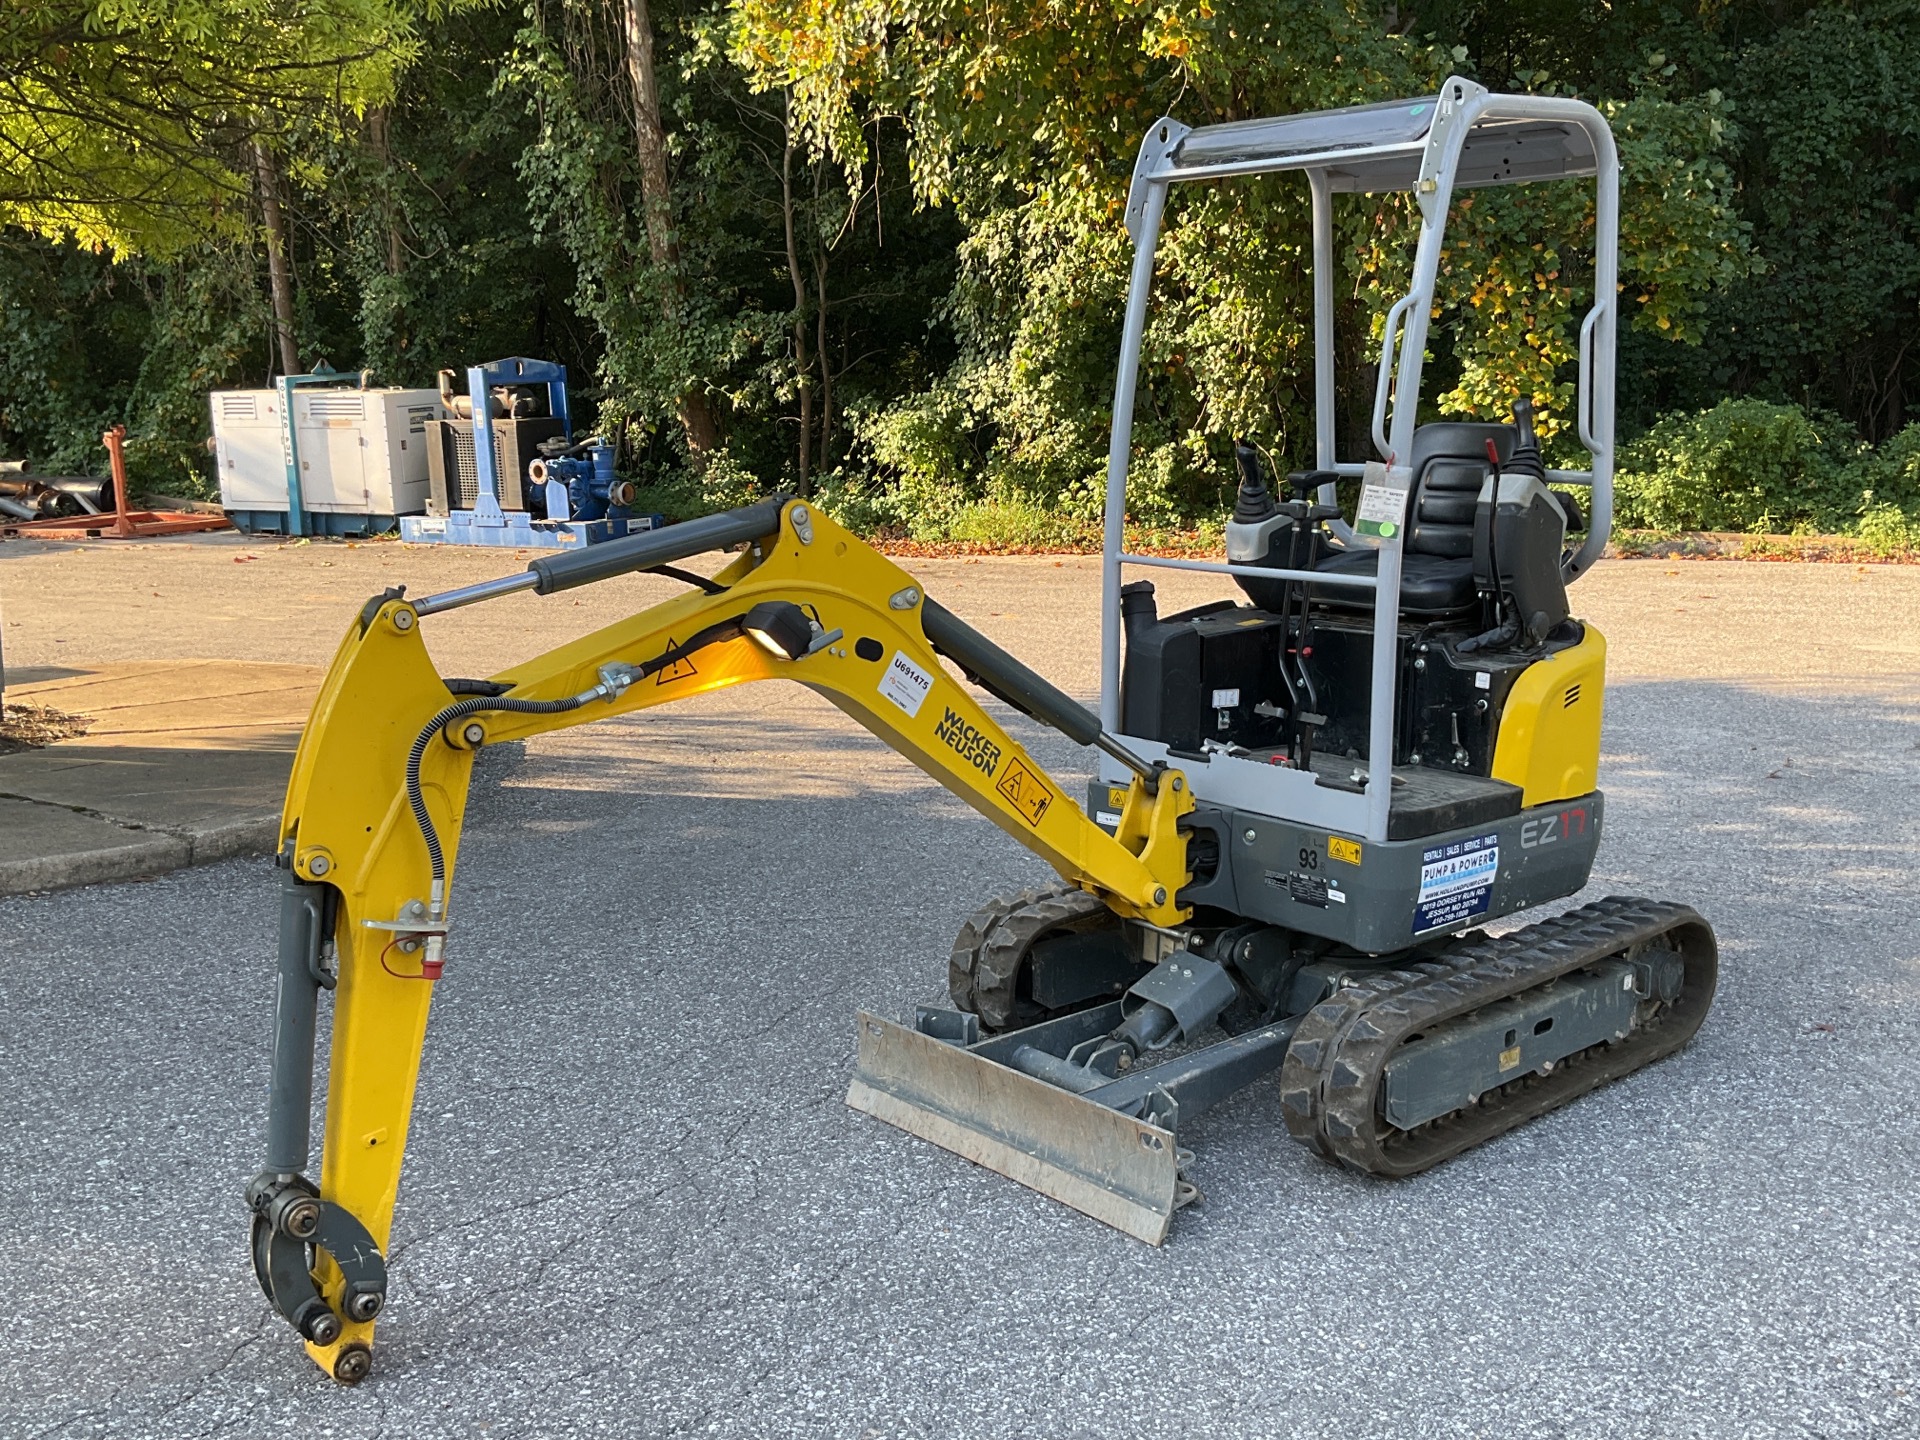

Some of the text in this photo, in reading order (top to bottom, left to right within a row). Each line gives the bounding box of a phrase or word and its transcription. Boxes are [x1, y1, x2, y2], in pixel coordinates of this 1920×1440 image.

[279, 378, 288, 428] HOLLAND
[894, 658, 929, 690] U691475
[934, 720, 997, 778] NEUSON
[943, 705, 1002, 764] WACKER
[1520, 808, 1586, 849] EZ17
[1299, 848, 1318, 870] 93
[1423, 834, 1497, 862] RENTALS SALES SERVICE PARTS
[1424, 853, 1489, 882] PUMP & POWER
[1424, 876, 1489, 900] WWW.HOLLANDPUMP.COM
[1436, 893, 1462, 908] DORSEY
[1462, 889, 1476, 900] RUN
[1451, 903, 1462, 912] MD
